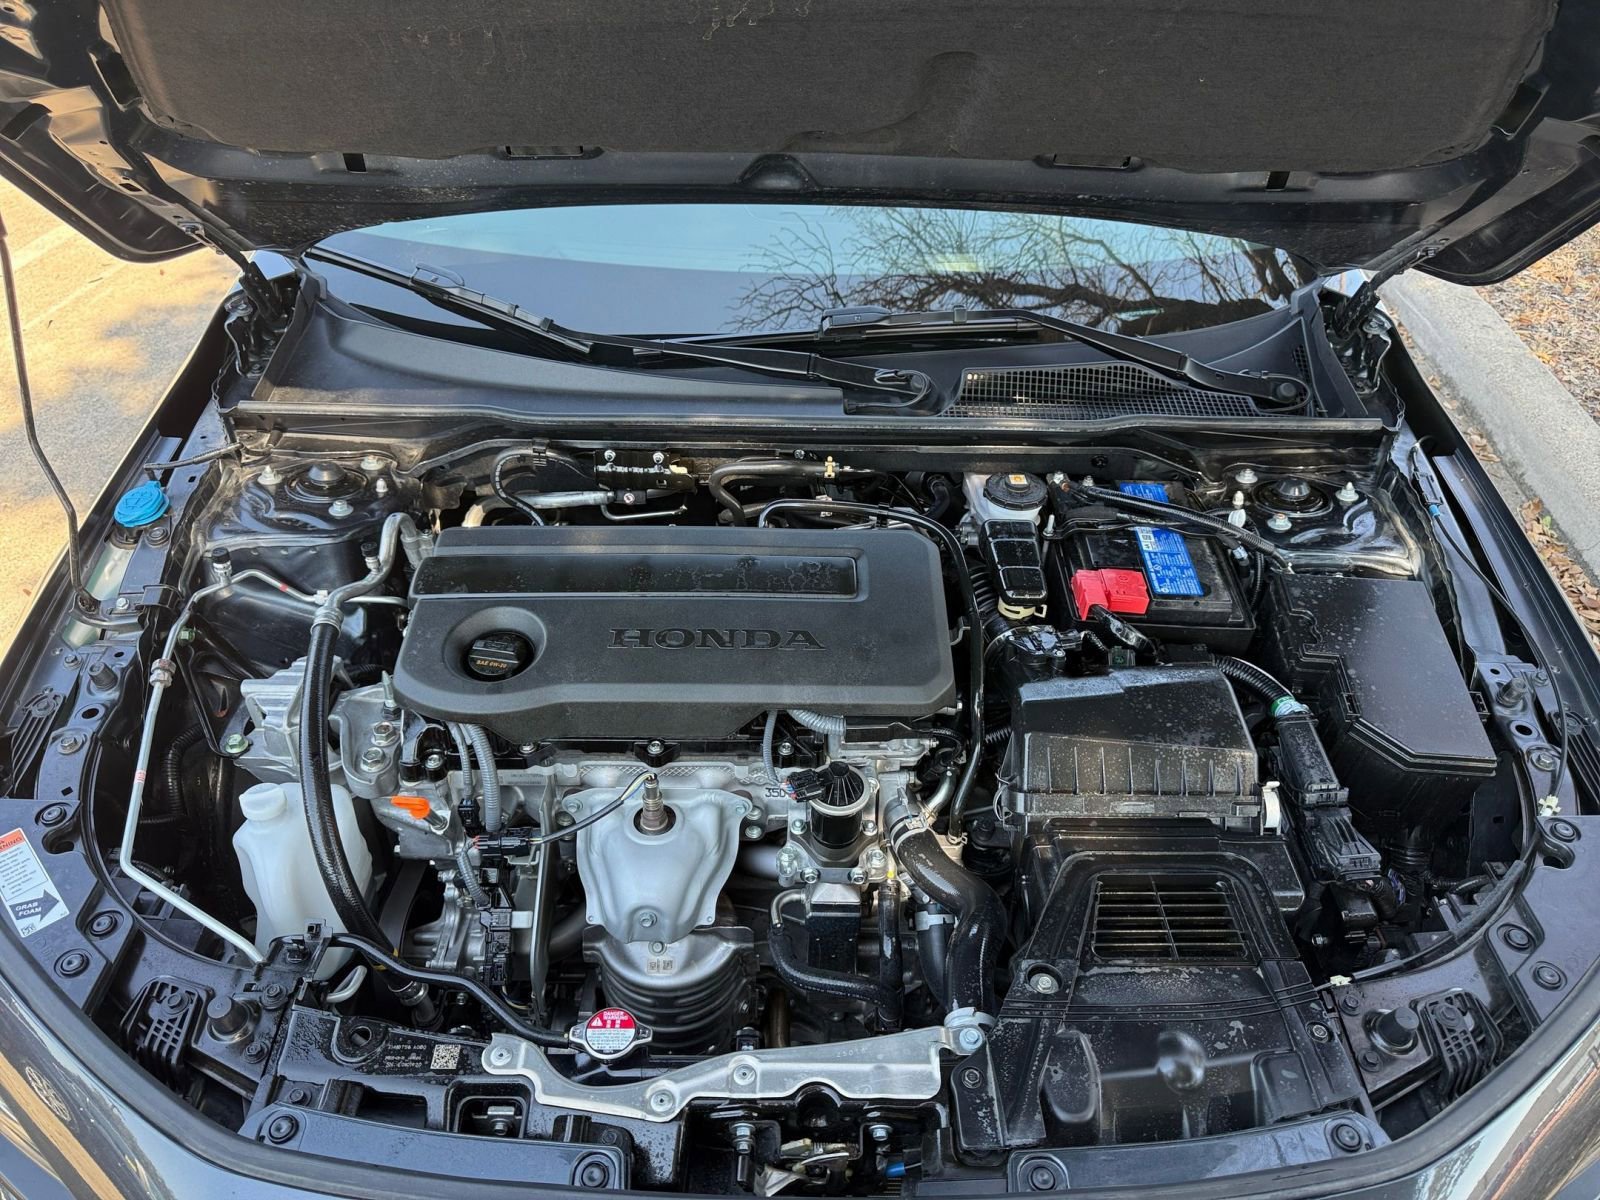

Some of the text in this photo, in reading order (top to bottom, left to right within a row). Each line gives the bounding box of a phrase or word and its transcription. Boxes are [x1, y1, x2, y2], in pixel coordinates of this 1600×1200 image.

[607, 628, 828, 650] HONDA
[15, 901, 39, 912] GRAB
[18, 907, 42, 917] FOAM
